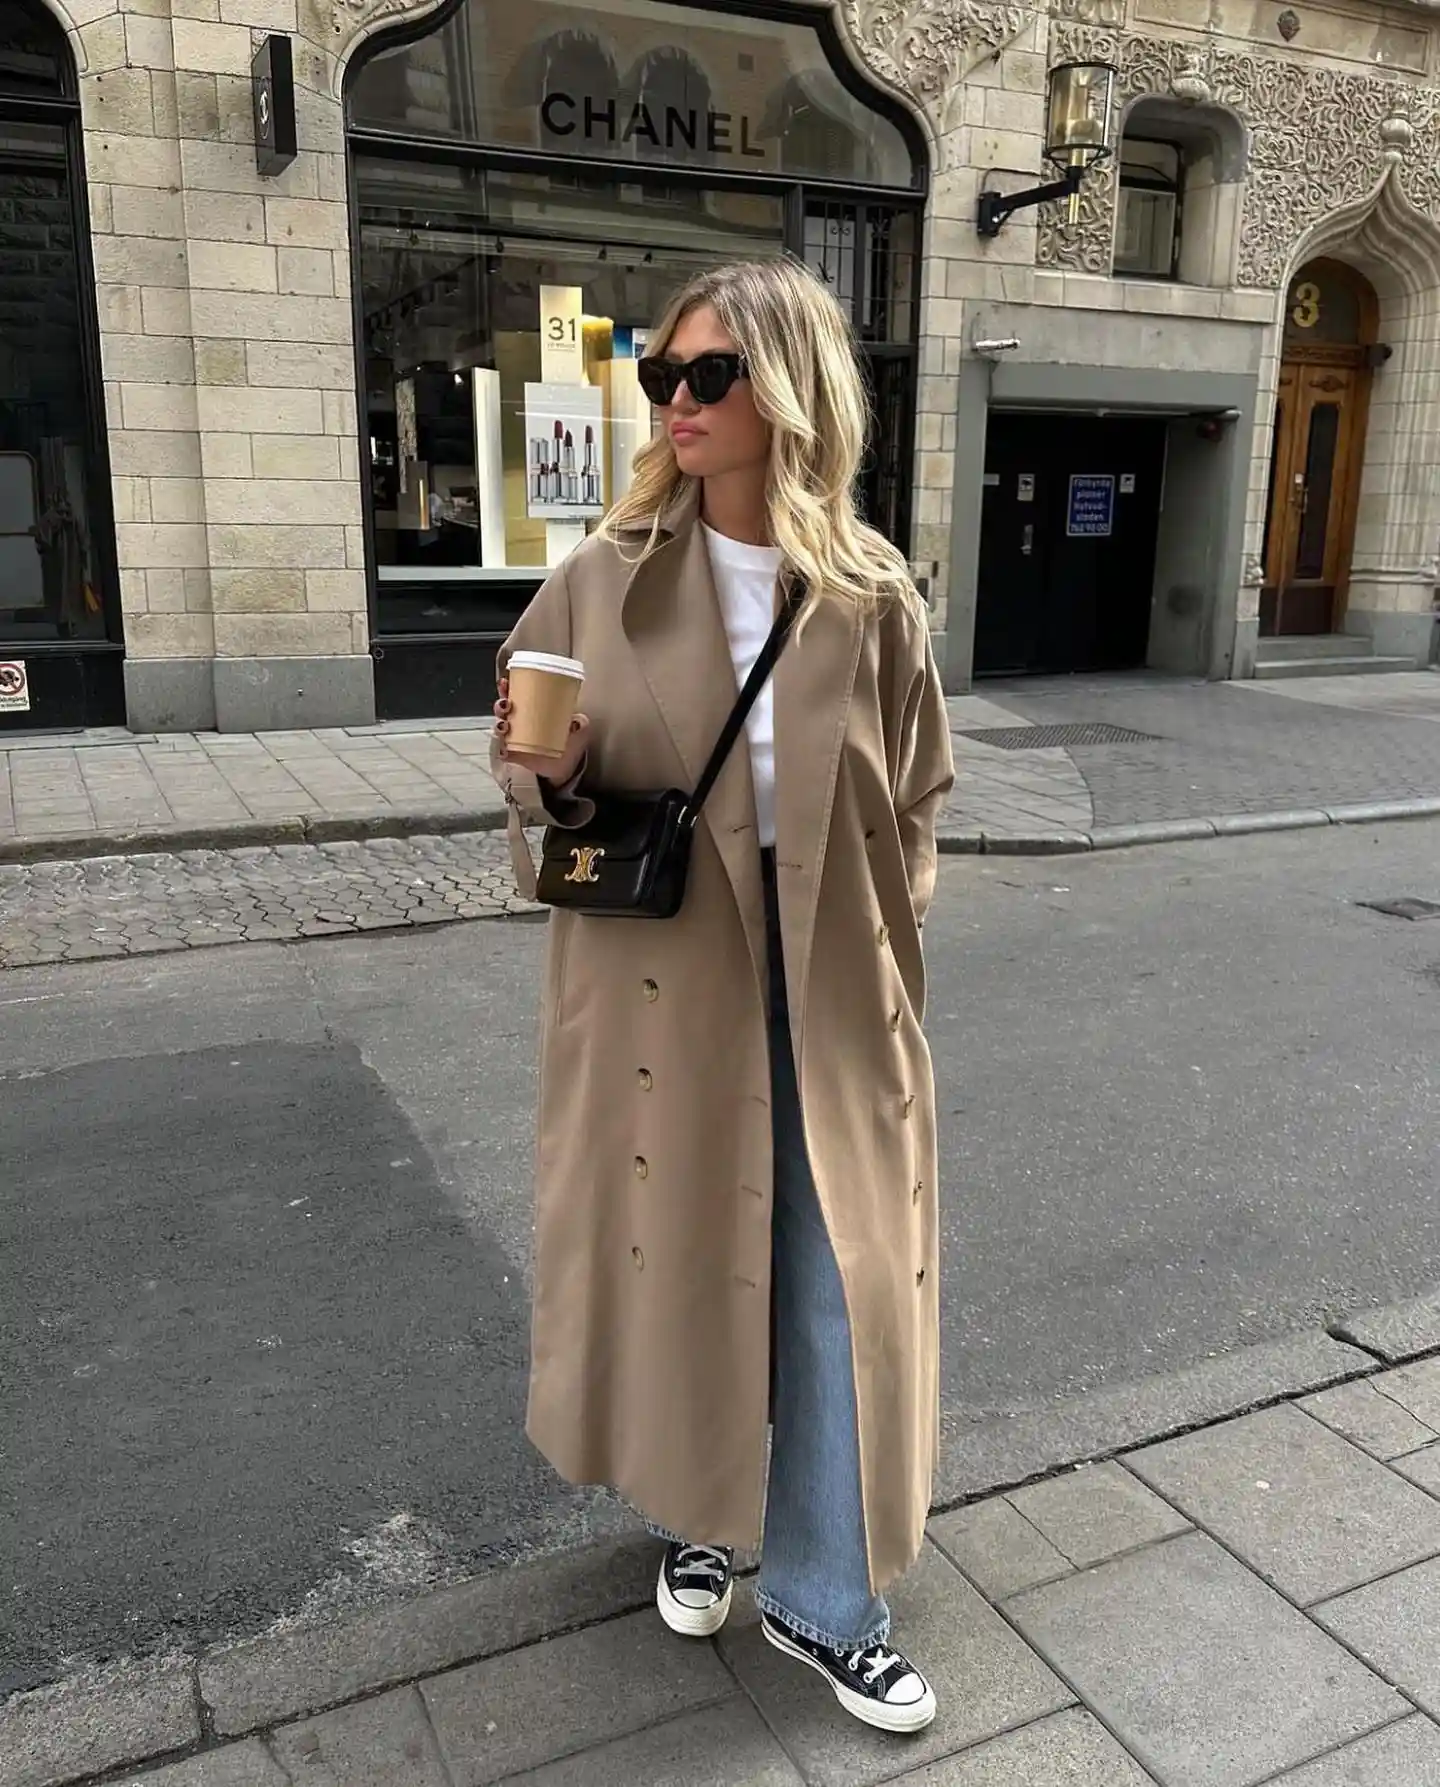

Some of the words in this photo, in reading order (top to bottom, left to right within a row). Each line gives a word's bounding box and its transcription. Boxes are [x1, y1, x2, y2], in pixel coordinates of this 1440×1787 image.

[541, 92, 765, 158] CHANEL
[1292, 282, 1321, 328] 3
[548, 316, 576, 342] 31
